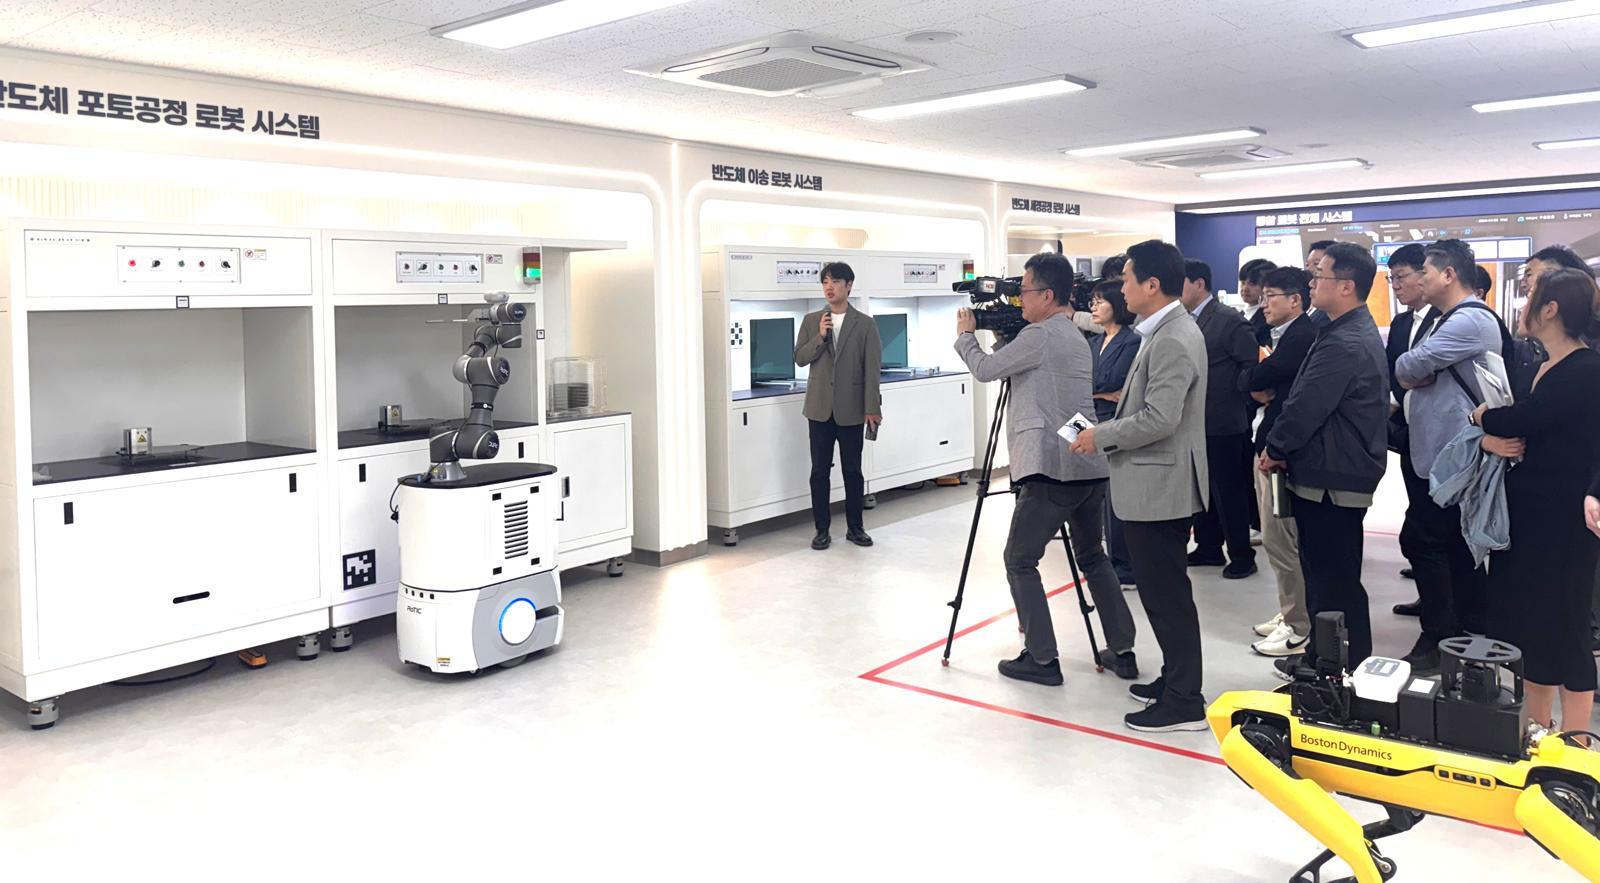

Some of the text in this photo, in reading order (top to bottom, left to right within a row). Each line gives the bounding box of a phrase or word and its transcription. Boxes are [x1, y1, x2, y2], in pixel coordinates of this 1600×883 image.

[77, 89, 188, 126] 포토공정
[195, 103, 245, 132] 로봇
[251, 110, 321, 140] 시스템
[711, 164, 823, 191] 반도체 이송 로봇 시스템
[1011, 197, 1030, 211] 반도체
[1321, 210, 1353, 223] 시스템
